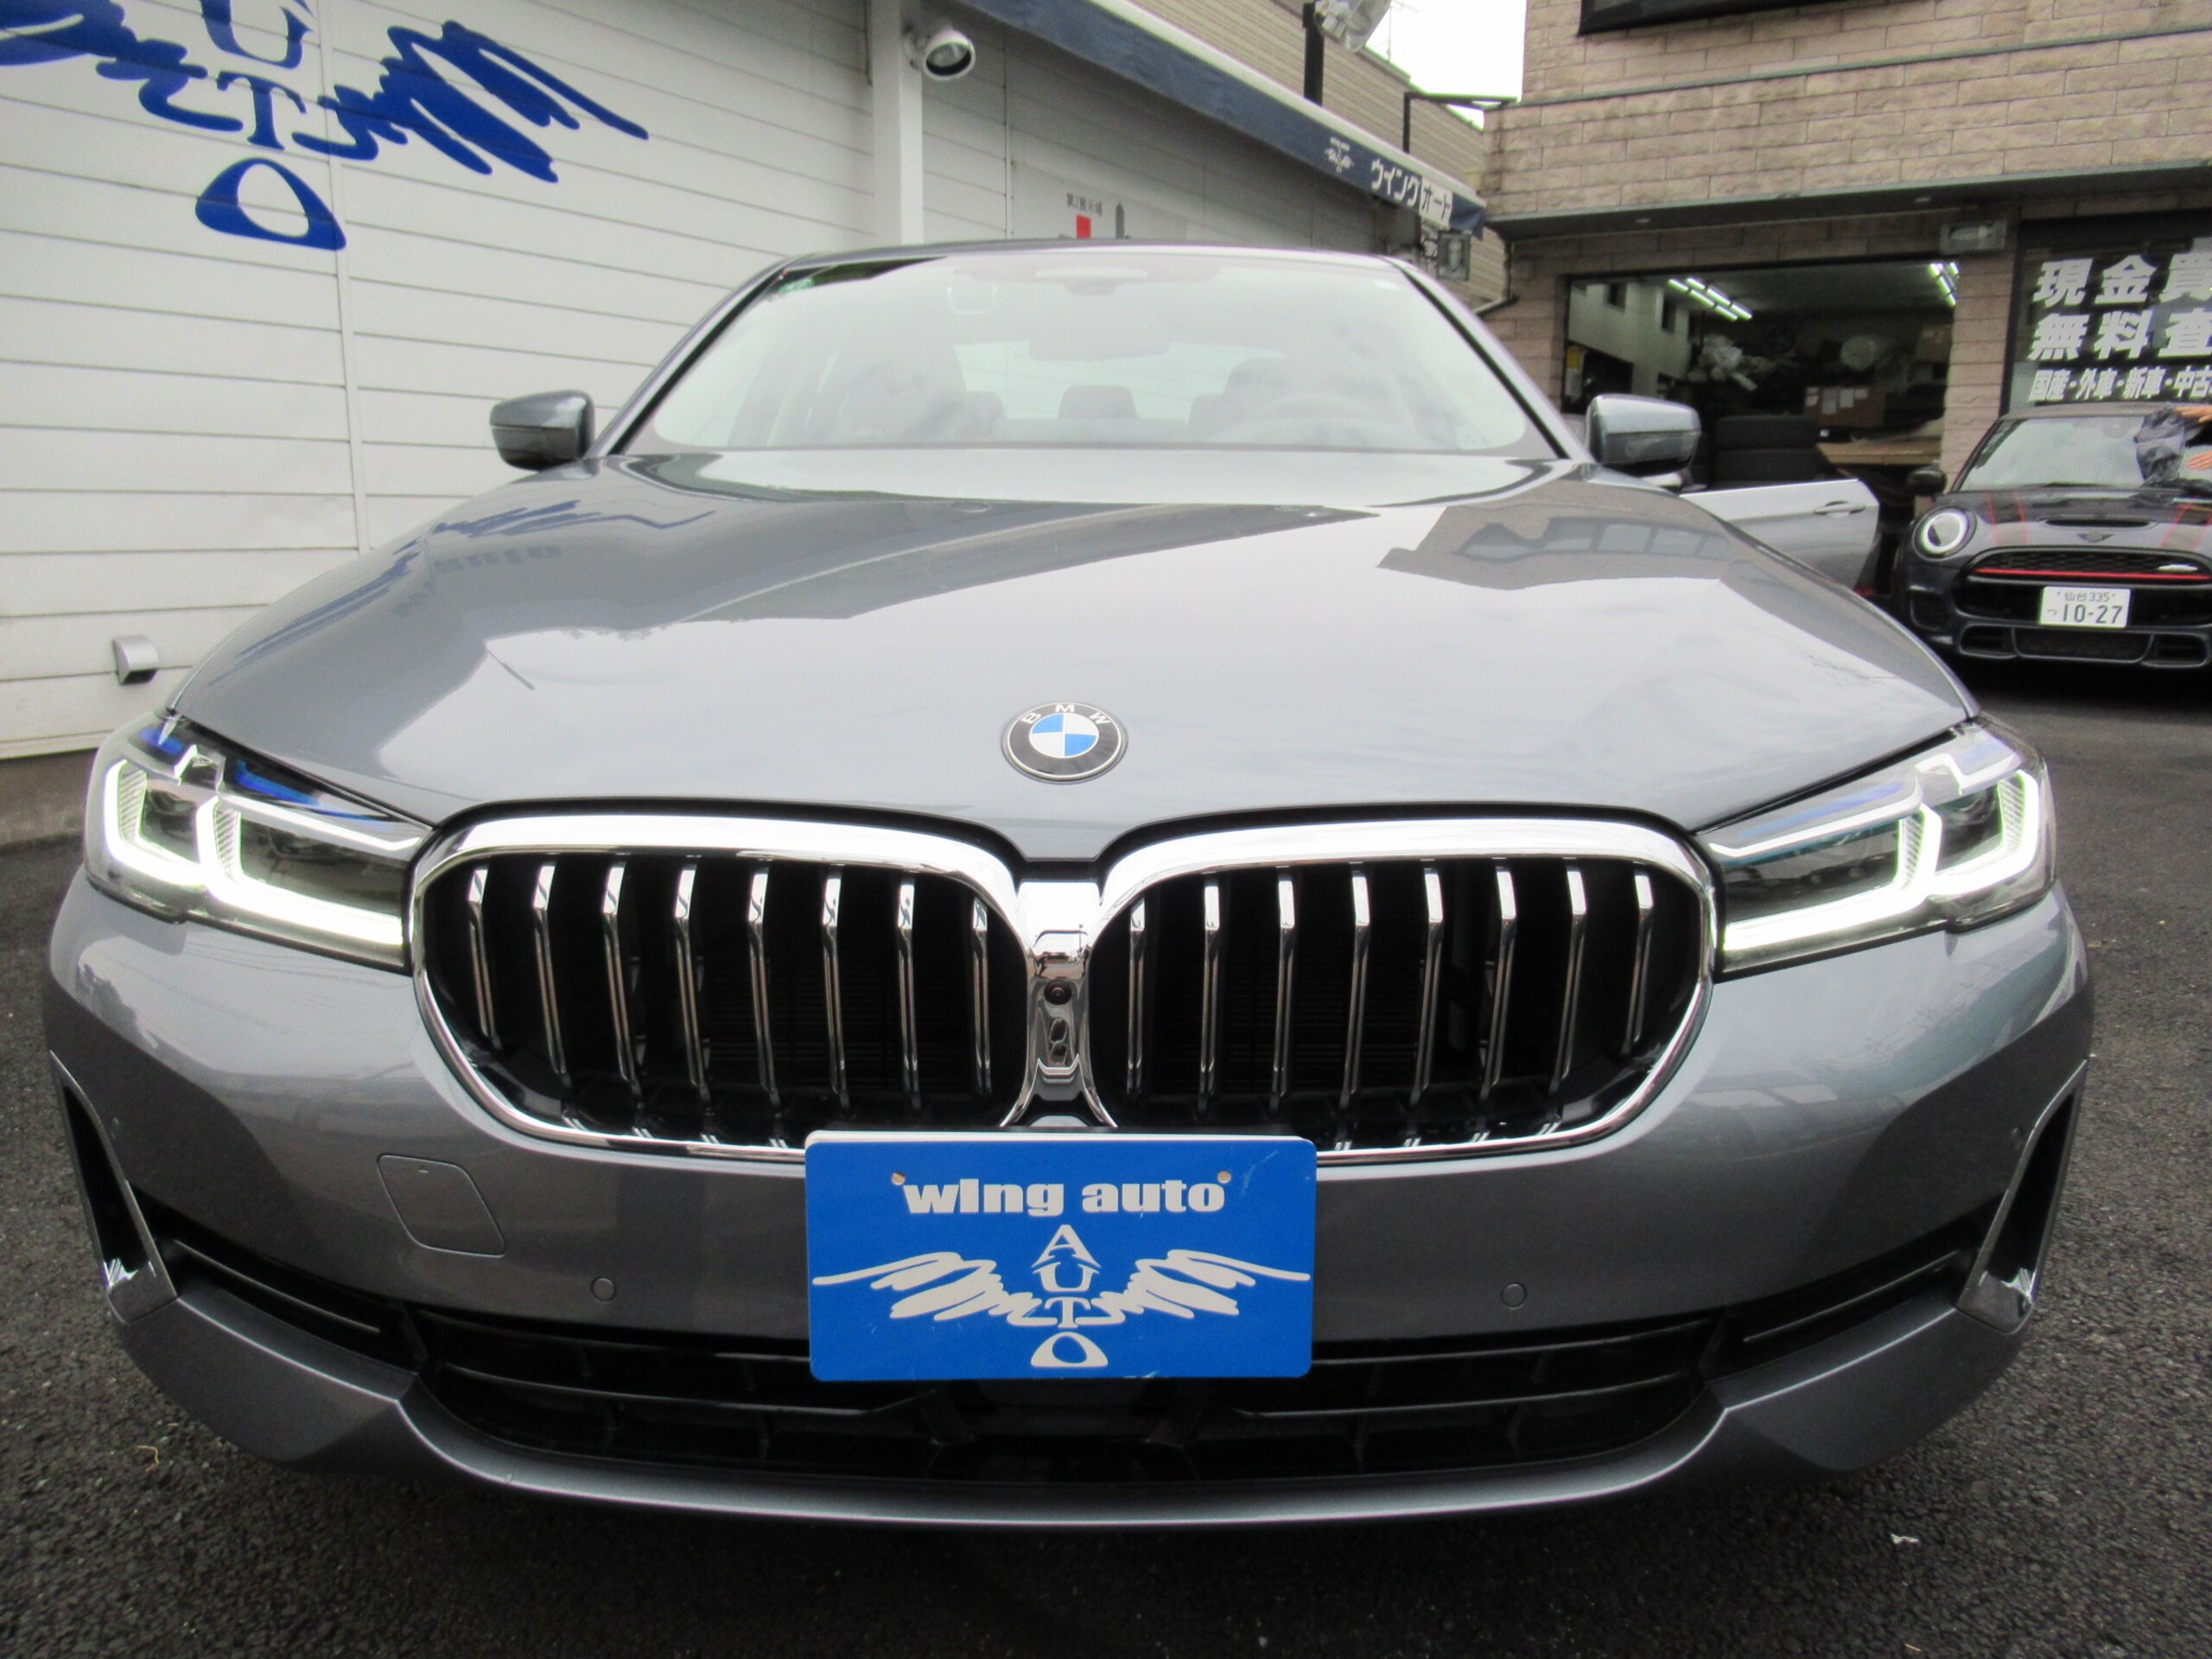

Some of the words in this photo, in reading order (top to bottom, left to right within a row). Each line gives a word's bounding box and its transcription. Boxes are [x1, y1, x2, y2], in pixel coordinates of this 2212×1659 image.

[1370, 159, 1452, 220] ウイングオート
[2031, 252, 2212, 307] 現金買
[2028, 308, 2212, 360] 無料査
[2028, 365, 2212, 402] 国産・外車・新車・中古
[2063, 604, 2124, 624] 10-27
[1020, 704, 1111, 724] BMW
[901, 1179, 1064, 1217] wing
[1081, 1179, 1225, 1213] auto
